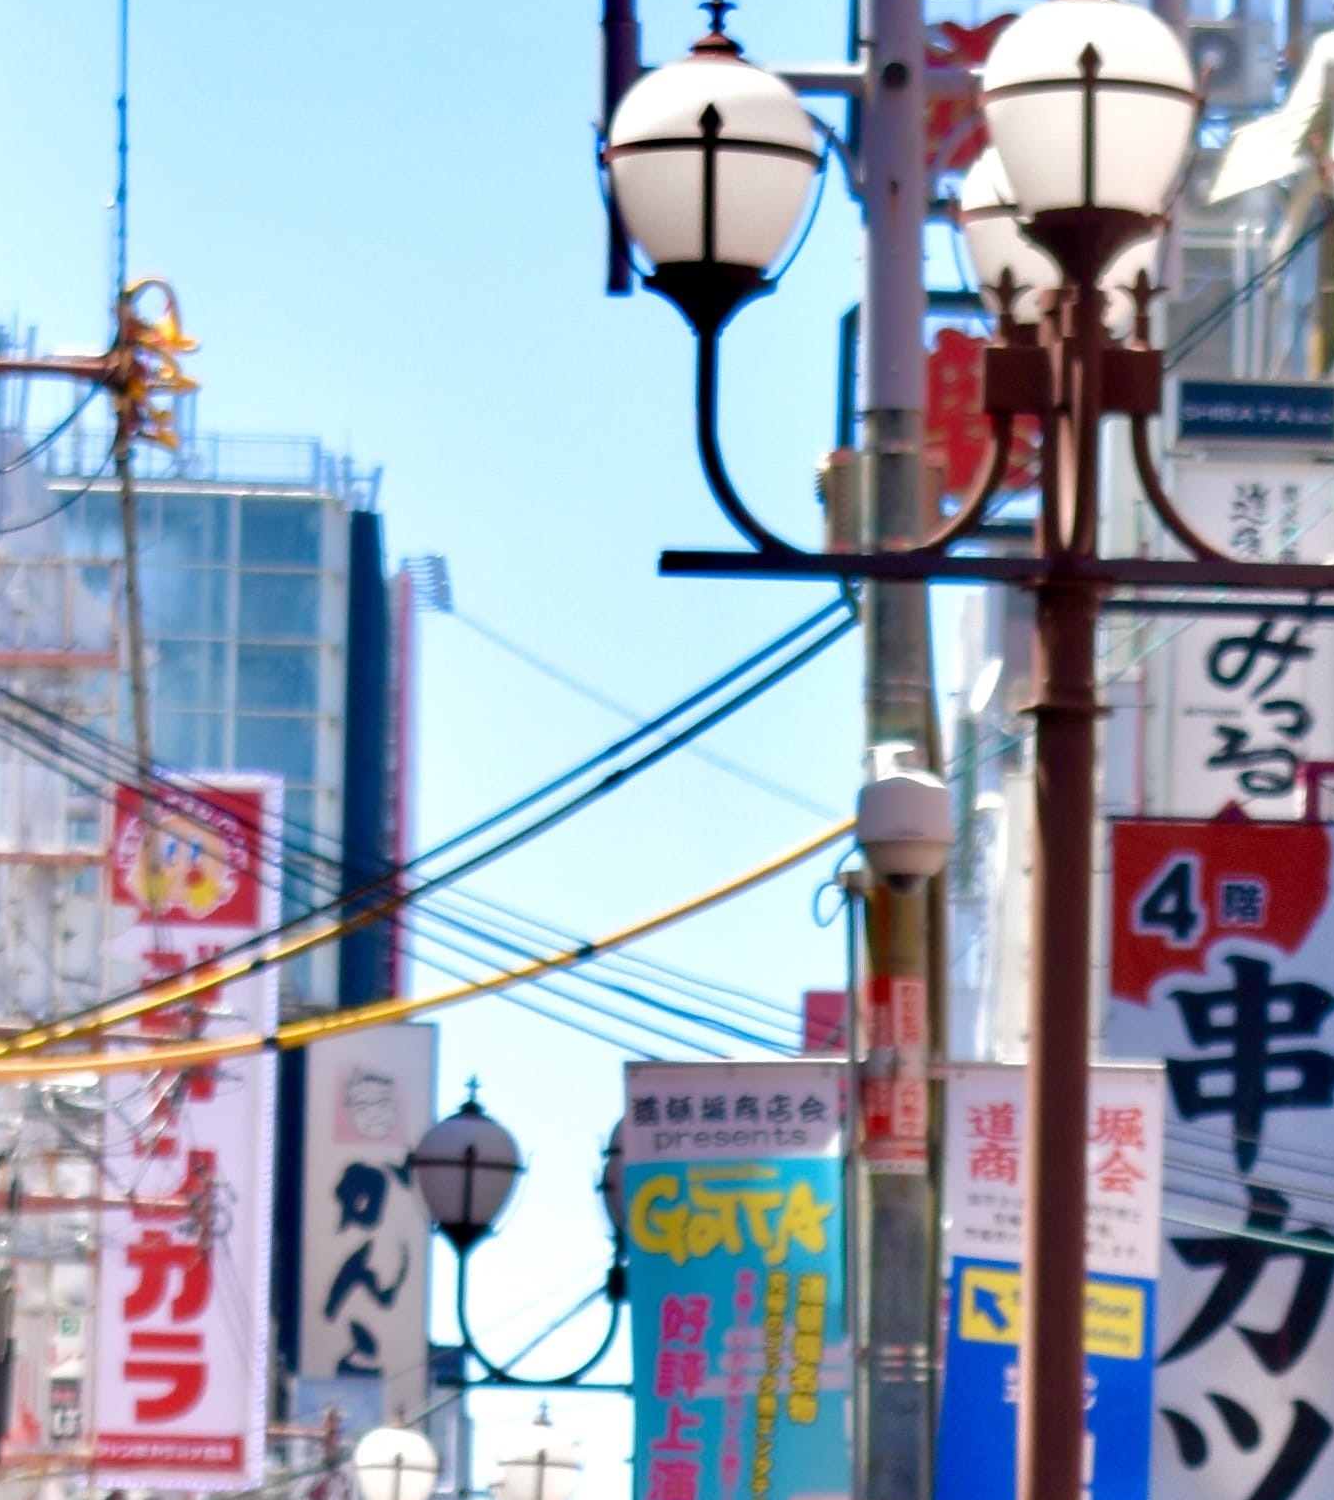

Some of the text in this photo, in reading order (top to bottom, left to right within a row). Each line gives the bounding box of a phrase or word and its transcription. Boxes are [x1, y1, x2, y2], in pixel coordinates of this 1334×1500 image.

[1137, 859, 1265, 943] 4階
[653, 1127, 807, 1152] presents
[967, 1102, 1146, 1151] 道堀
[968, 1140, 1146, 1195] 商会
